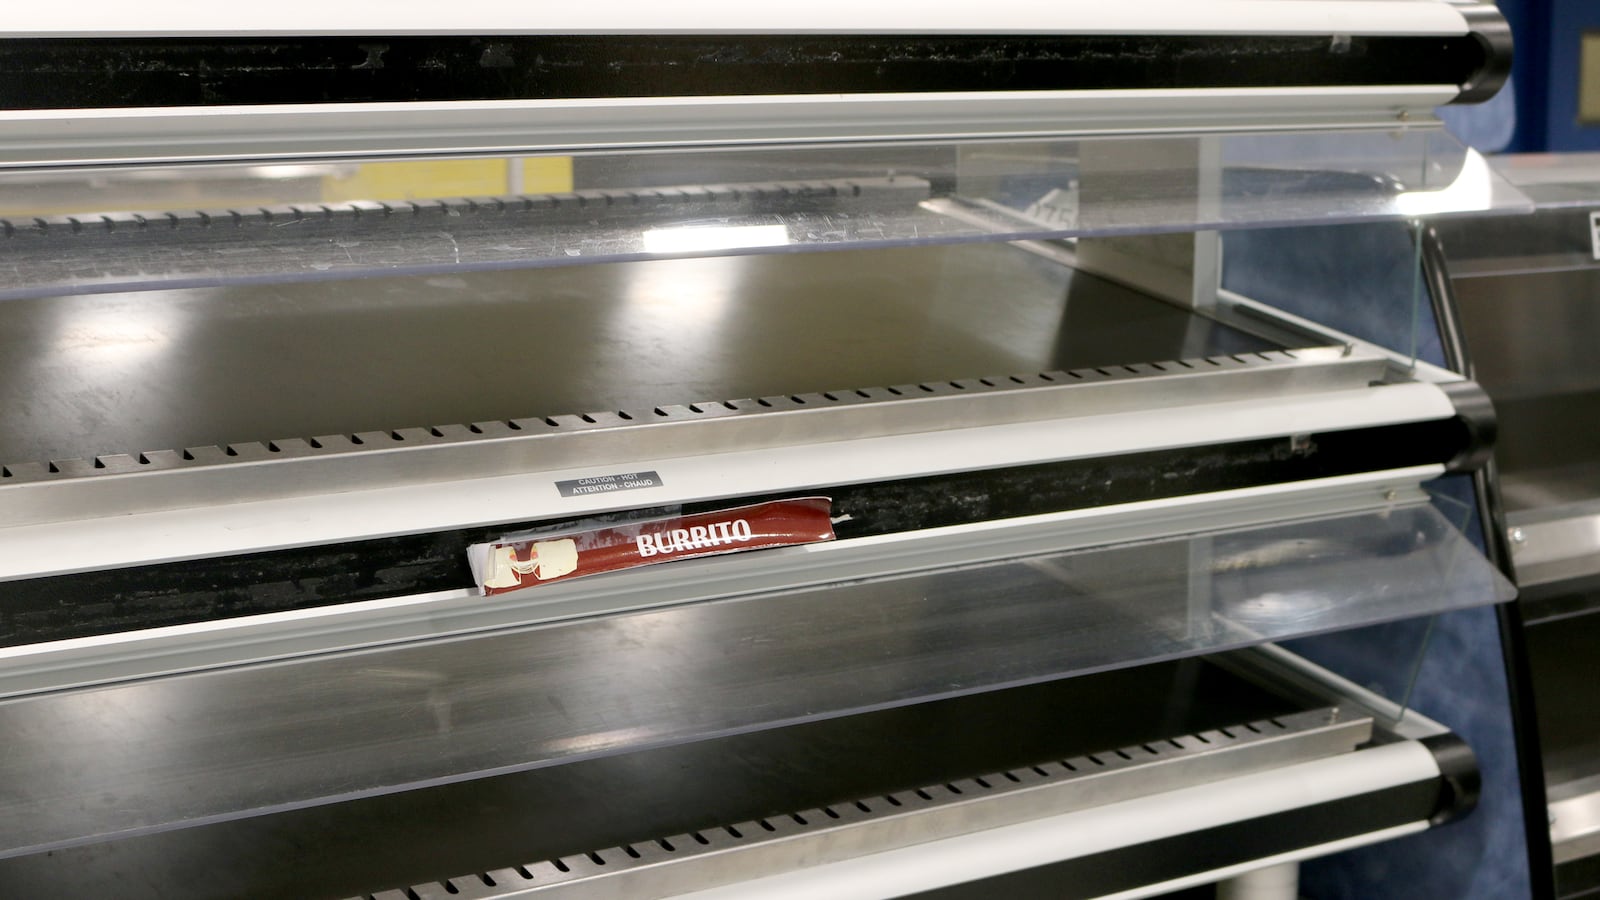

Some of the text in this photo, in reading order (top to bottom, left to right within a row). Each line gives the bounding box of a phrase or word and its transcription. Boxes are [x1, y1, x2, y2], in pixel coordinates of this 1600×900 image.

[572, 483, 618, 494] ATTENTION
[624, 479, 653, 488] CHAUD
[578, 476, 615, 485] CAUTION
[620, 473, 639, 481] HOT
[636, 519, 752, 557] BURRITO
